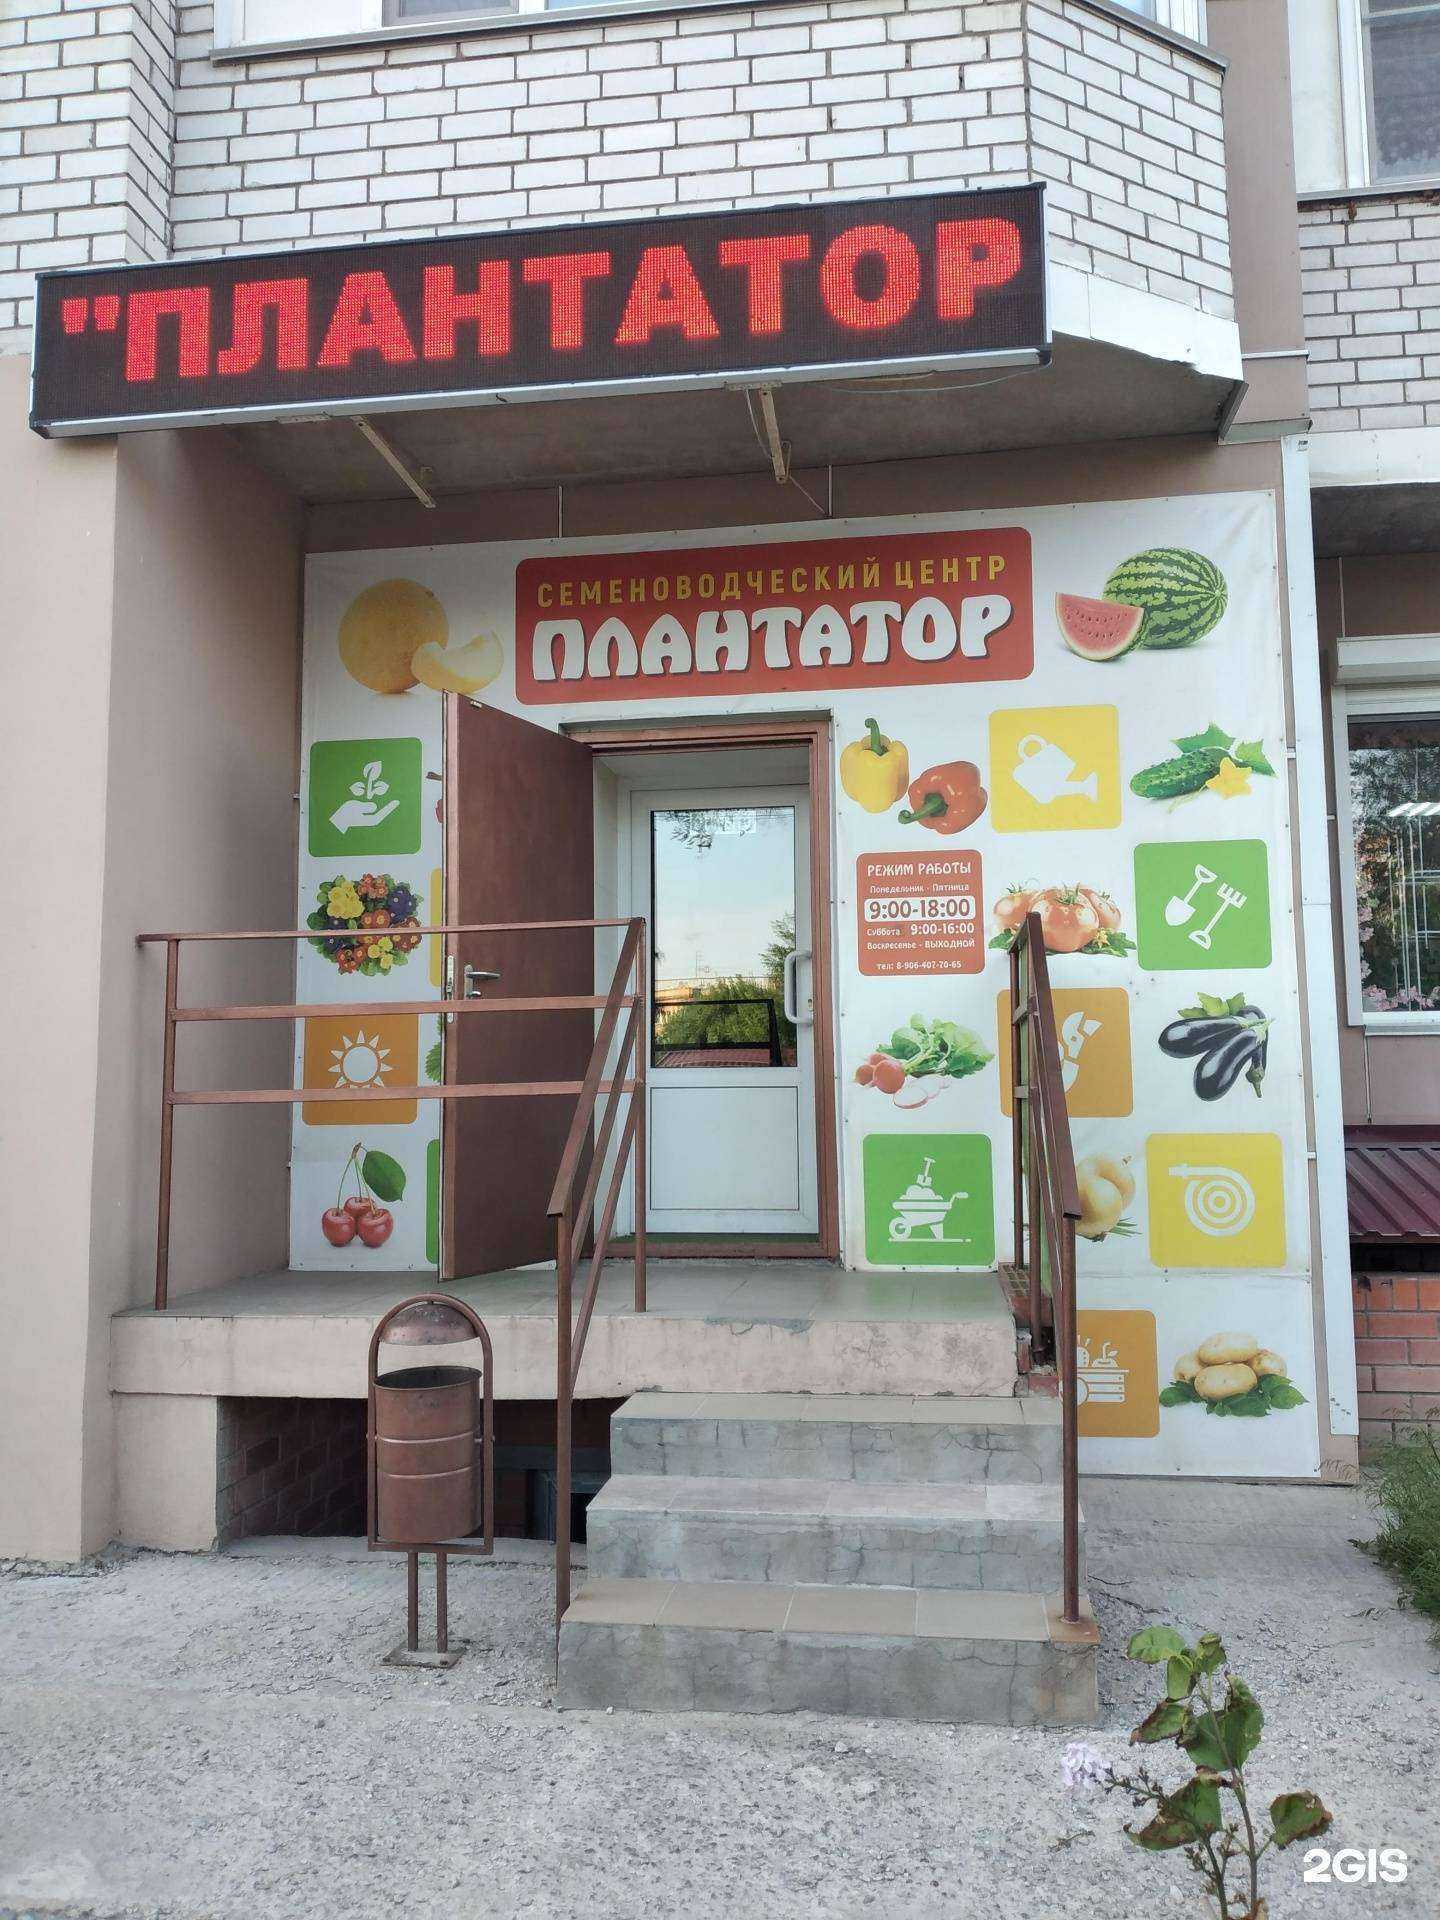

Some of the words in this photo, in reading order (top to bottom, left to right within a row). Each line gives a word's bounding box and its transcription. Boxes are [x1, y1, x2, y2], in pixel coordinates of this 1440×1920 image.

[536, 557, 882, 608] СЕМЕНОВОДЧЕСКИЙ
[895, 555, 1008, 588] ЦЕНТР
[532, 594, 1013, 682] ПЛАНТАТОР
[867, 863, 914, 876] РЕЖИМ
[918, 862, 971, 875] РАБОТЫ
[870, 885, 924, 894] Понедельник
[932, 883, 969, 892] Пятница
[869, 898, 970, 919] 9:00-18:00
[911, 923, 975, 935] 9:00-16:00
[867, 942, 916, 950] Воскресенье
[924, 938, 976, 949] ВЫХОДНОЙ
